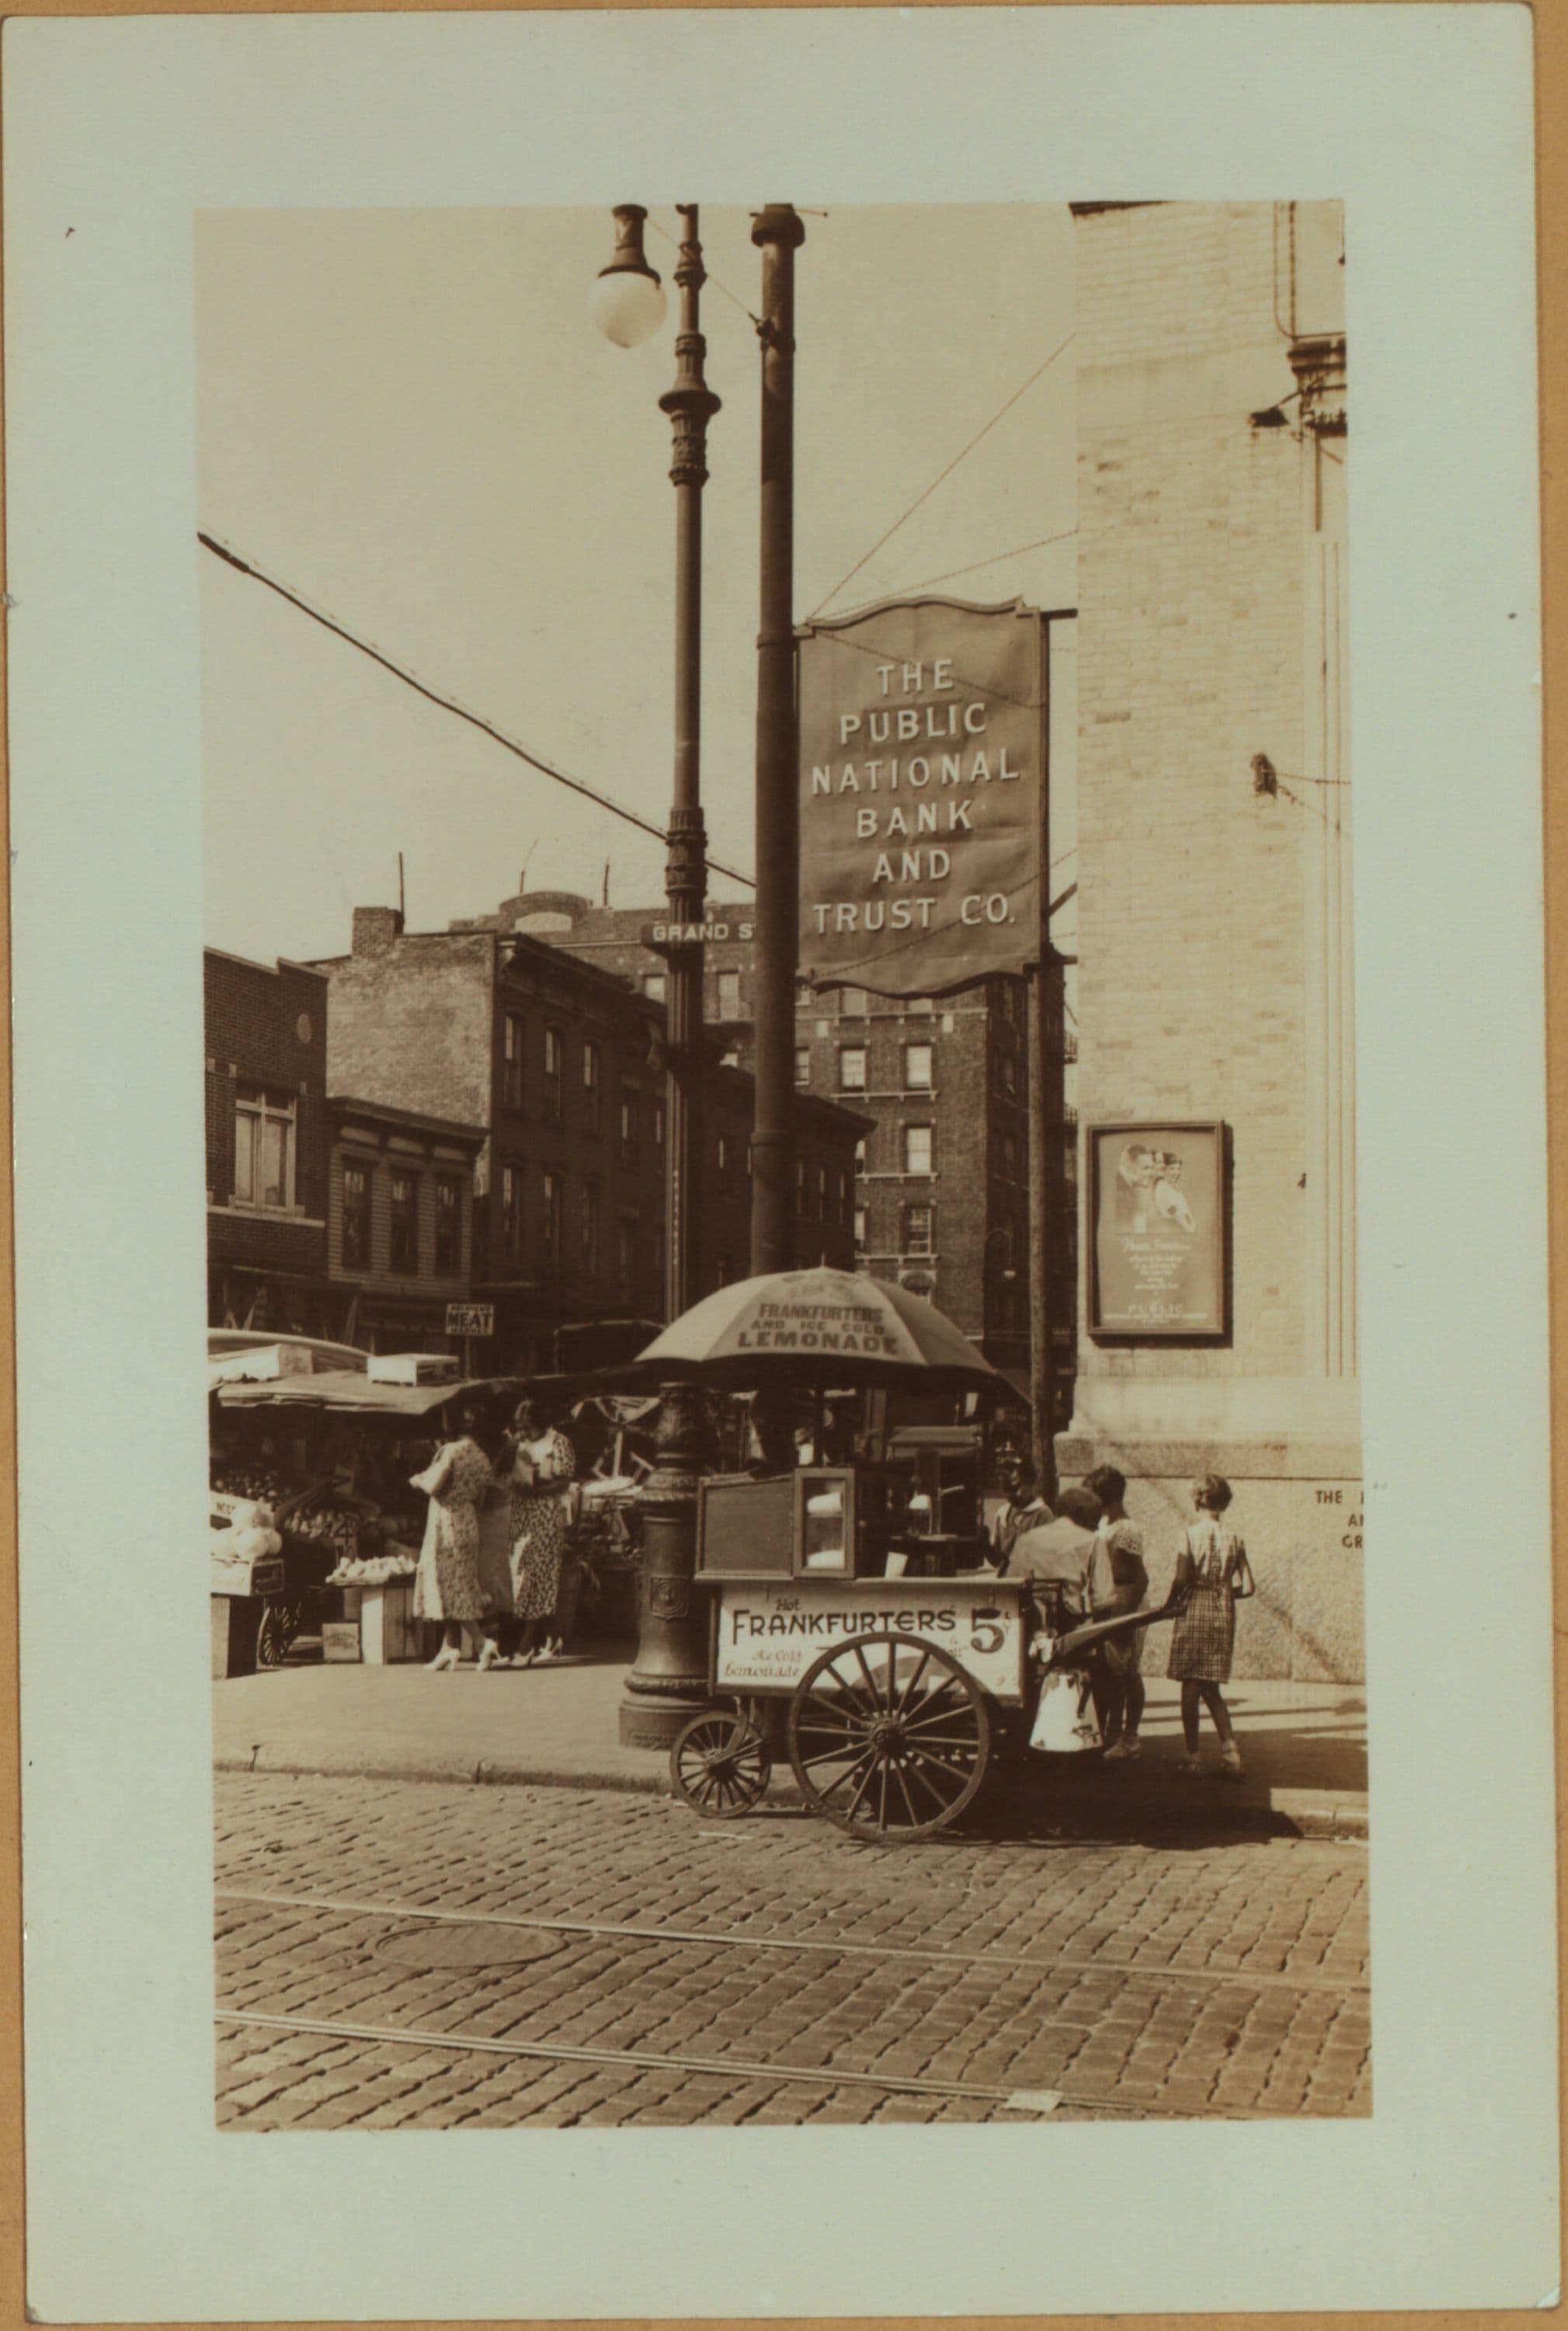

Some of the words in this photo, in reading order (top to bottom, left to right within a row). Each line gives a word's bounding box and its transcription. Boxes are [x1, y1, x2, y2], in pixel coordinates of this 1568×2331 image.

[876, 659, 955, 695] THE
[840, 702, 986, 744] PUBLIC
[812, 747, 1021, 795] NATIONAL
[856, 800, 973, 839] BANK
[872, 850, 951, 883] AND
[813, 898, 938, 934] TRUST
[960, 895, 1017, 927] CO.
[652, 924, 728, 942] GRAND
[739, 923, 756, 940] S
[448, 1312, 491, 1327] MEAT
[758, 1303, 883, 1322] FRANKFURTERS
[751, 1320, 785, 1331] AND
[800, 1320, 827, 1331] ICE
[841, 1321, 885, 1335] COLD
[738, 1331, 899, 1355] LEMONADE
[1316, 1490, 1342, 1504] THE
[776, 1598, 801, 1611] Hot
[733, 1608, 956, 1645] FRANKFURTERS
